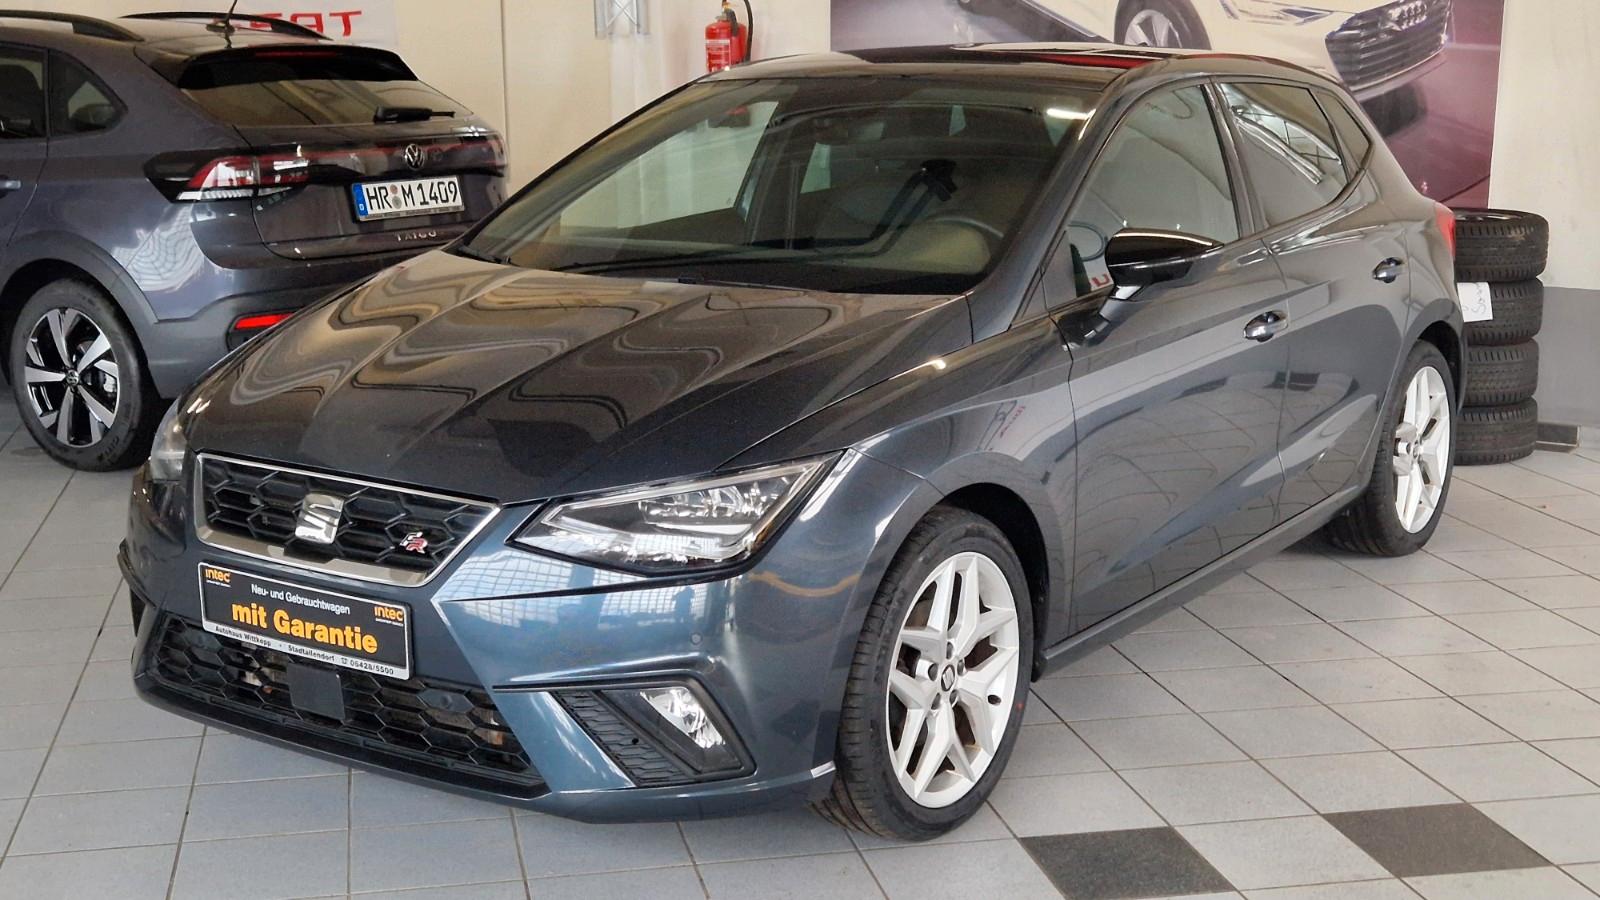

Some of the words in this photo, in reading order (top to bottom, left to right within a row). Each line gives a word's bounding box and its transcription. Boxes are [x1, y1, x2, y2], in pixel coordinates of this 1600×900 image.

[366, 186, 392, 210] HR
[401, 183, 416, 207] M
[416, 180, 458, 206] 1409
[205, 568, 231, 583] intec
[250, 583, 269, 596] Neu-
[270, 589, 284, 601] und
[285, 591, 350, 615] Gebrauchtwagen
[374, 606, 403, 622] intec
[215, 625, 243, 640] Autohaus
[288, 644, 335, 662] Stadtallendorf
[231, 603, 267, 629] mit
[273, 609, 378, 654] Garantie
